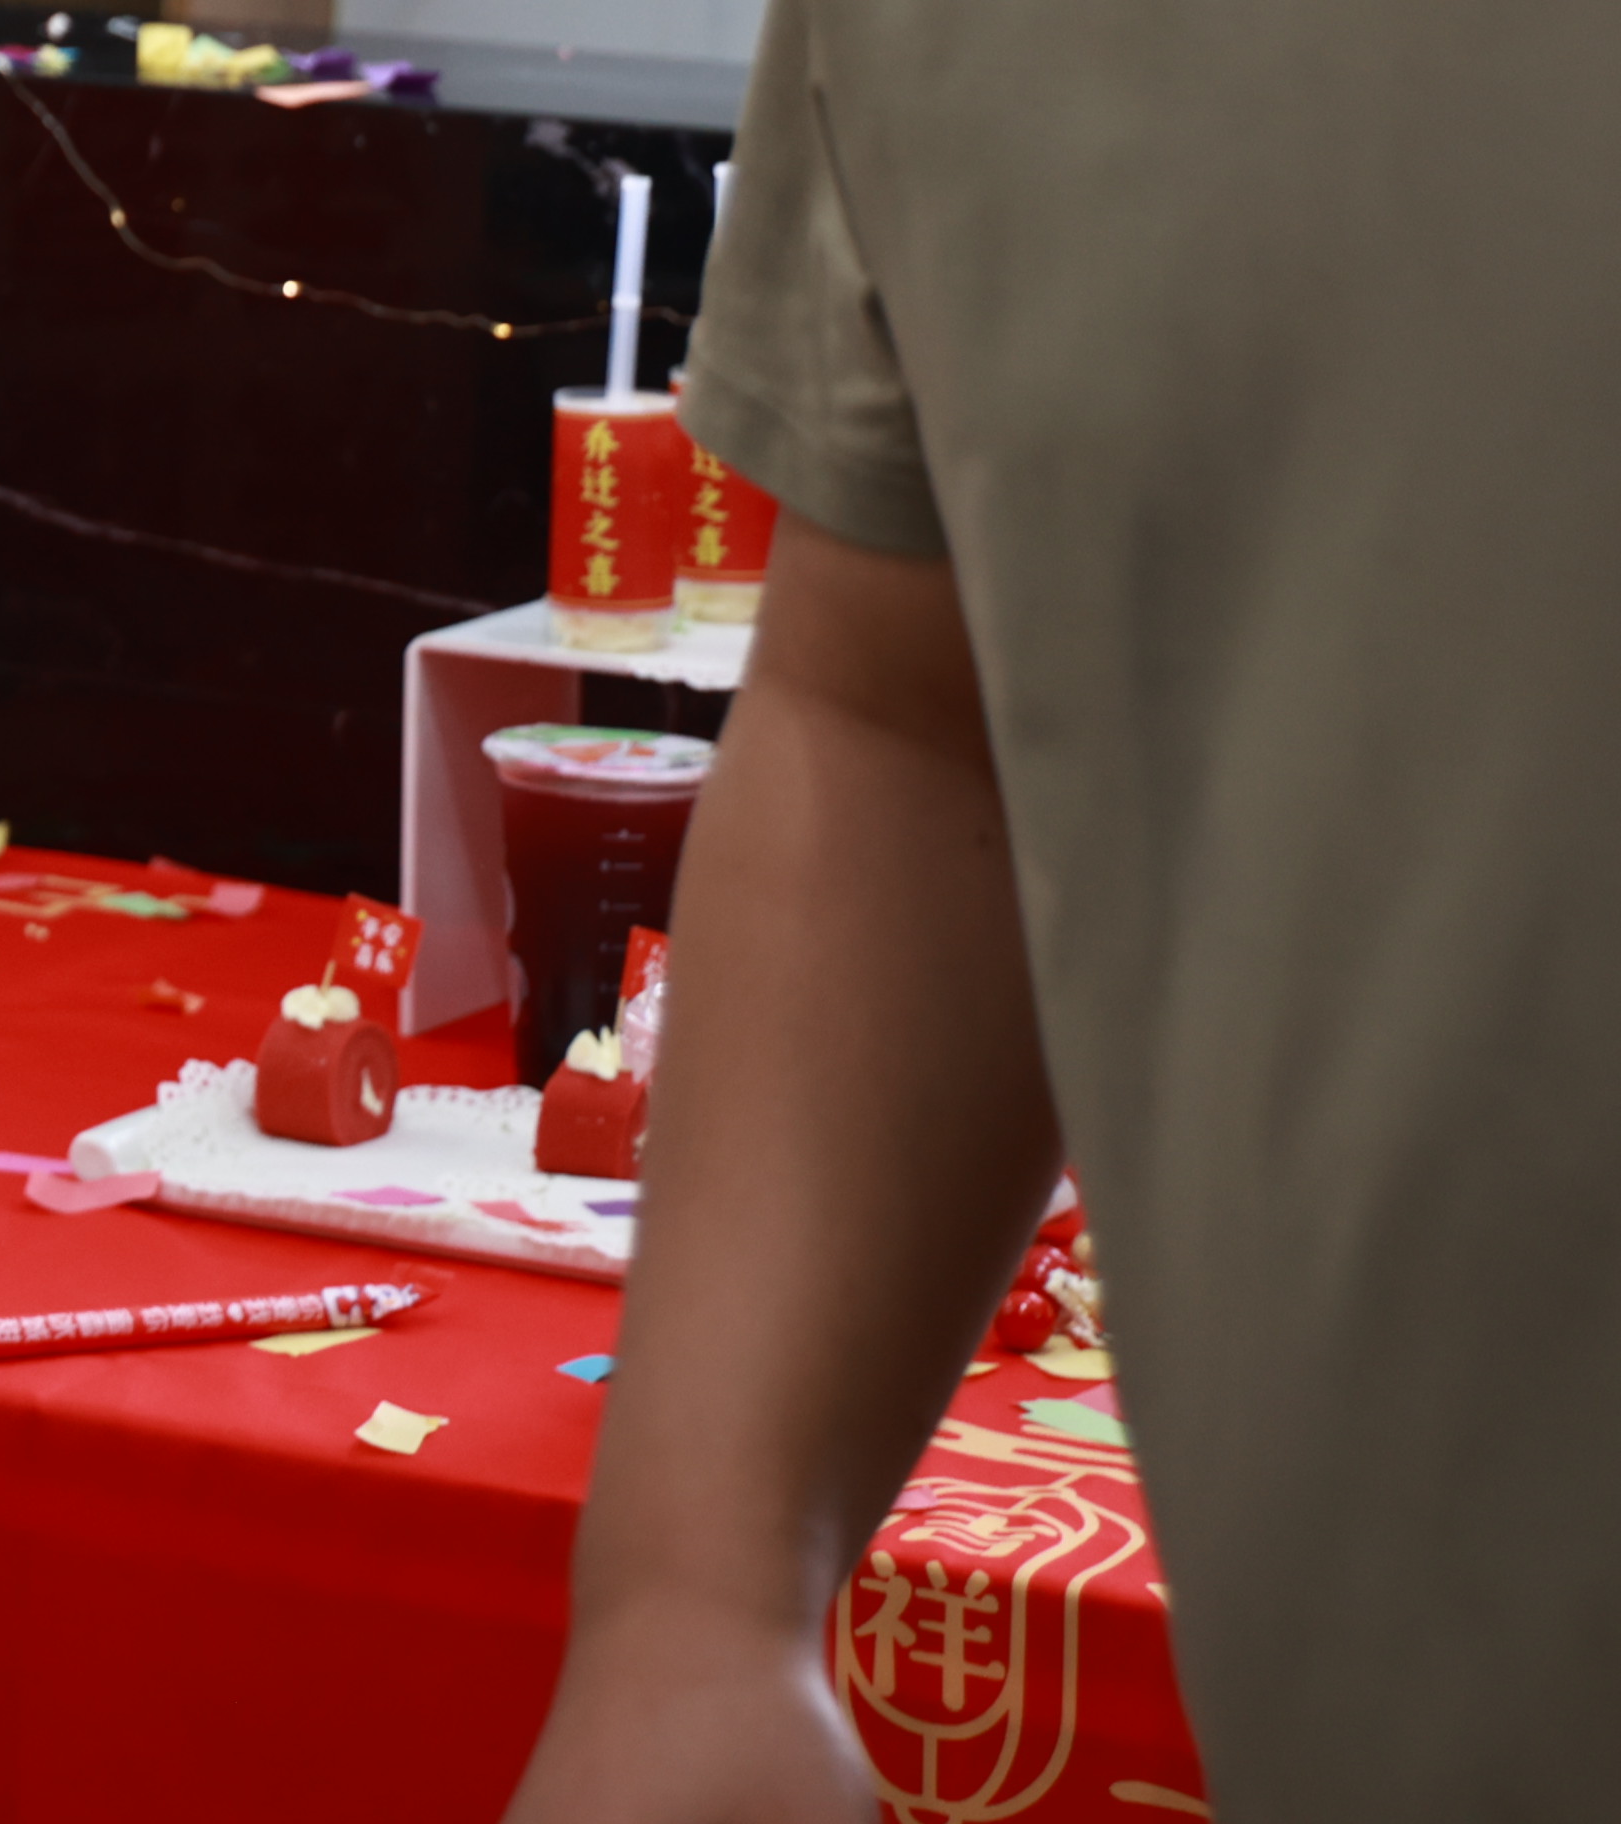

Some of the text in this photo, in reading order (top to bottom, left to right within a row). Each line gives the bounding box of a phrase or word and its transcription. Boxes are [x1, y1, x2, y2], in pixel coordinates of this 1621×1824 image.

[579, 418, 622, 597] 乔迁之喜
[855, 1551, 1006, 1712] 祥
